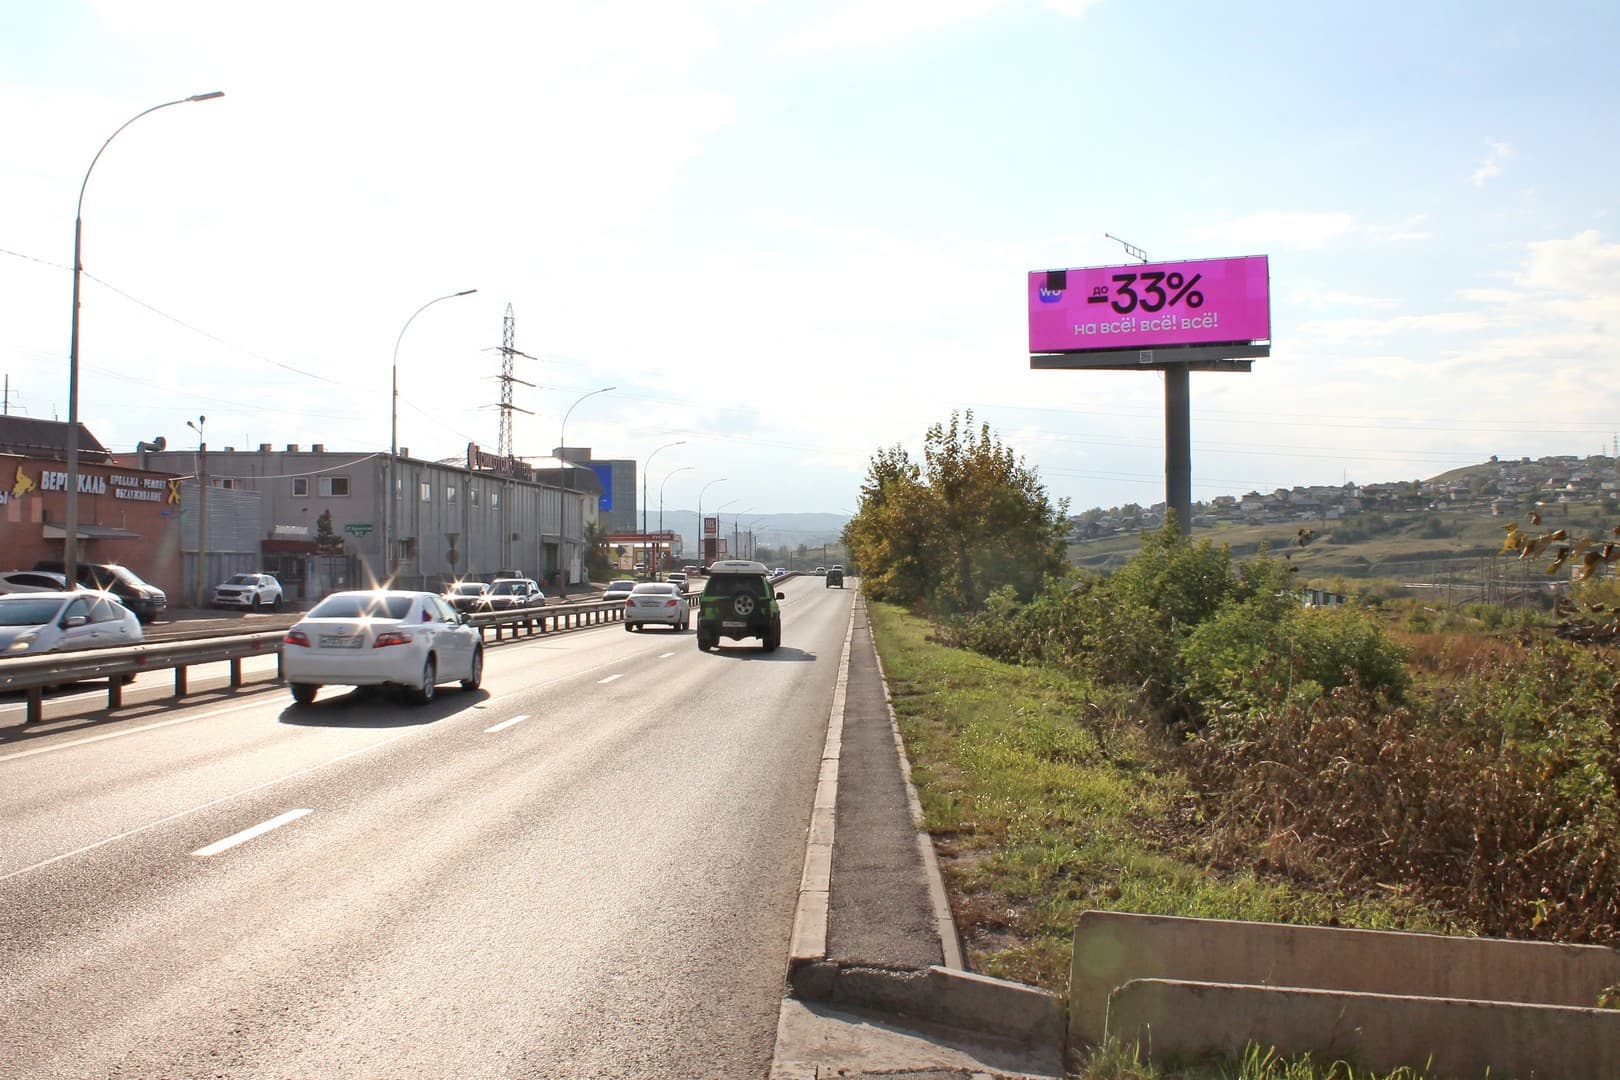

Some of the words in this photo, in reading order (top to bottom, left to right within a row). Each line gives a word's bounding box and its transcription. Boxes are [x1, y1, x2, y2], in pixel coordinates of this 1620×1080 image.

[1093, 285, 1109, 297] до
[1074, 323, 1097, 335] на
[1100, 316, 1137, 334] всё!
[1140, 314, 1177, 332] всё!
[1181, 312, 1218, 330] всё!
[41, 470, 107, 495] ВЕРТКАЛЬ
